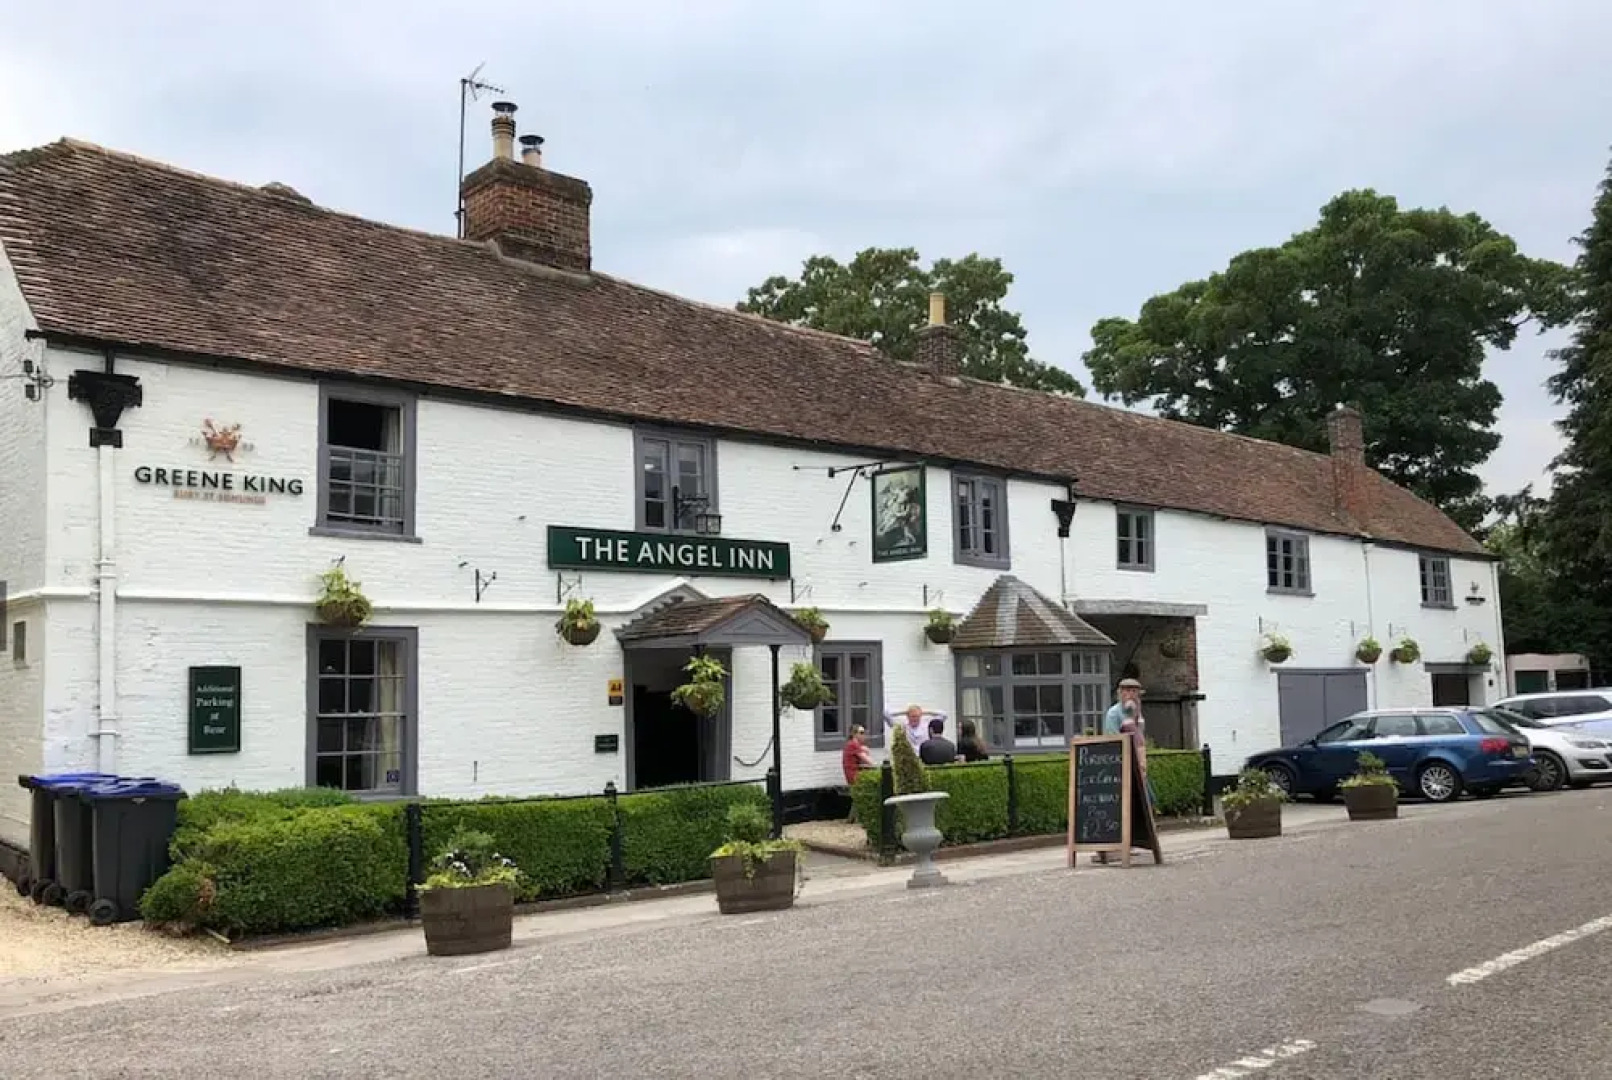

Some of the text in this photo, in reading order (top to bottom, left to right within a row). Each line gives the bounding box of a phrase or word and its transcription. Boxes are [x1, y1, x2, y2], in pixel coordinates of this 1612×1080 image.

[134, 466, 304, 496] GREENE KING
[575, 536, 774, 570] THE ANGEL INN
[196, 697, 234, 709] Parking
